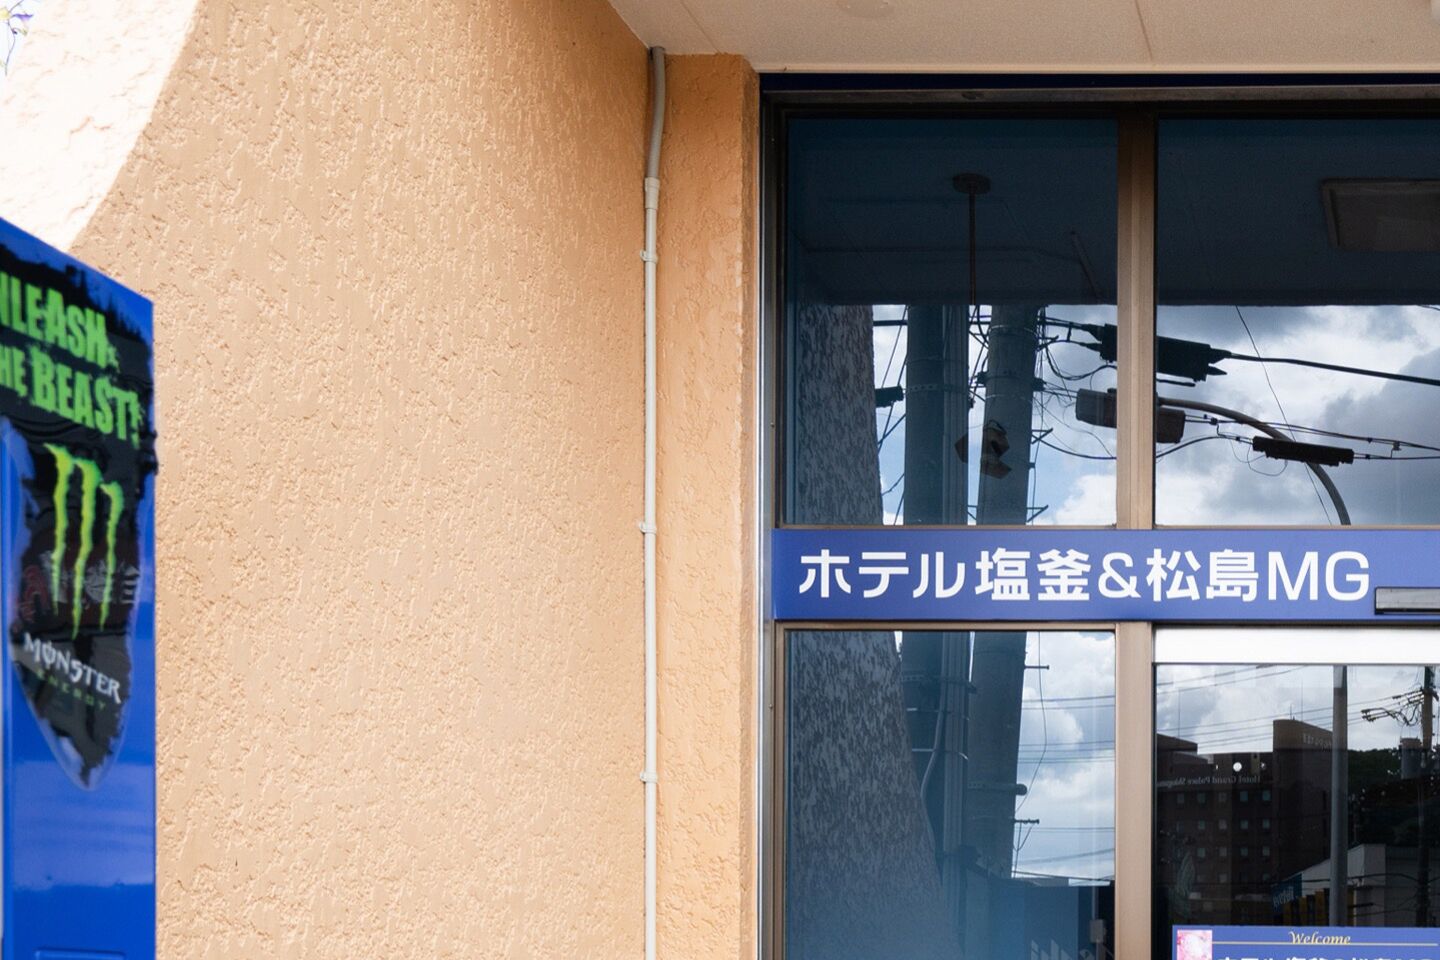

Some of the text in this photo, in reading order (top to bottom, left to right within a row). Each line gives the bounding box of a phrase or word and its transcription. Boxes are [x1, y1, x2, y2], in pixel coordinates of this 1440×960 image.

[31, 345, 142, 449] BEAST!
[798, 546, 1370, 602] ホテル塩釜&松島MG
[1288, 931, 1351, 945] Welcome
